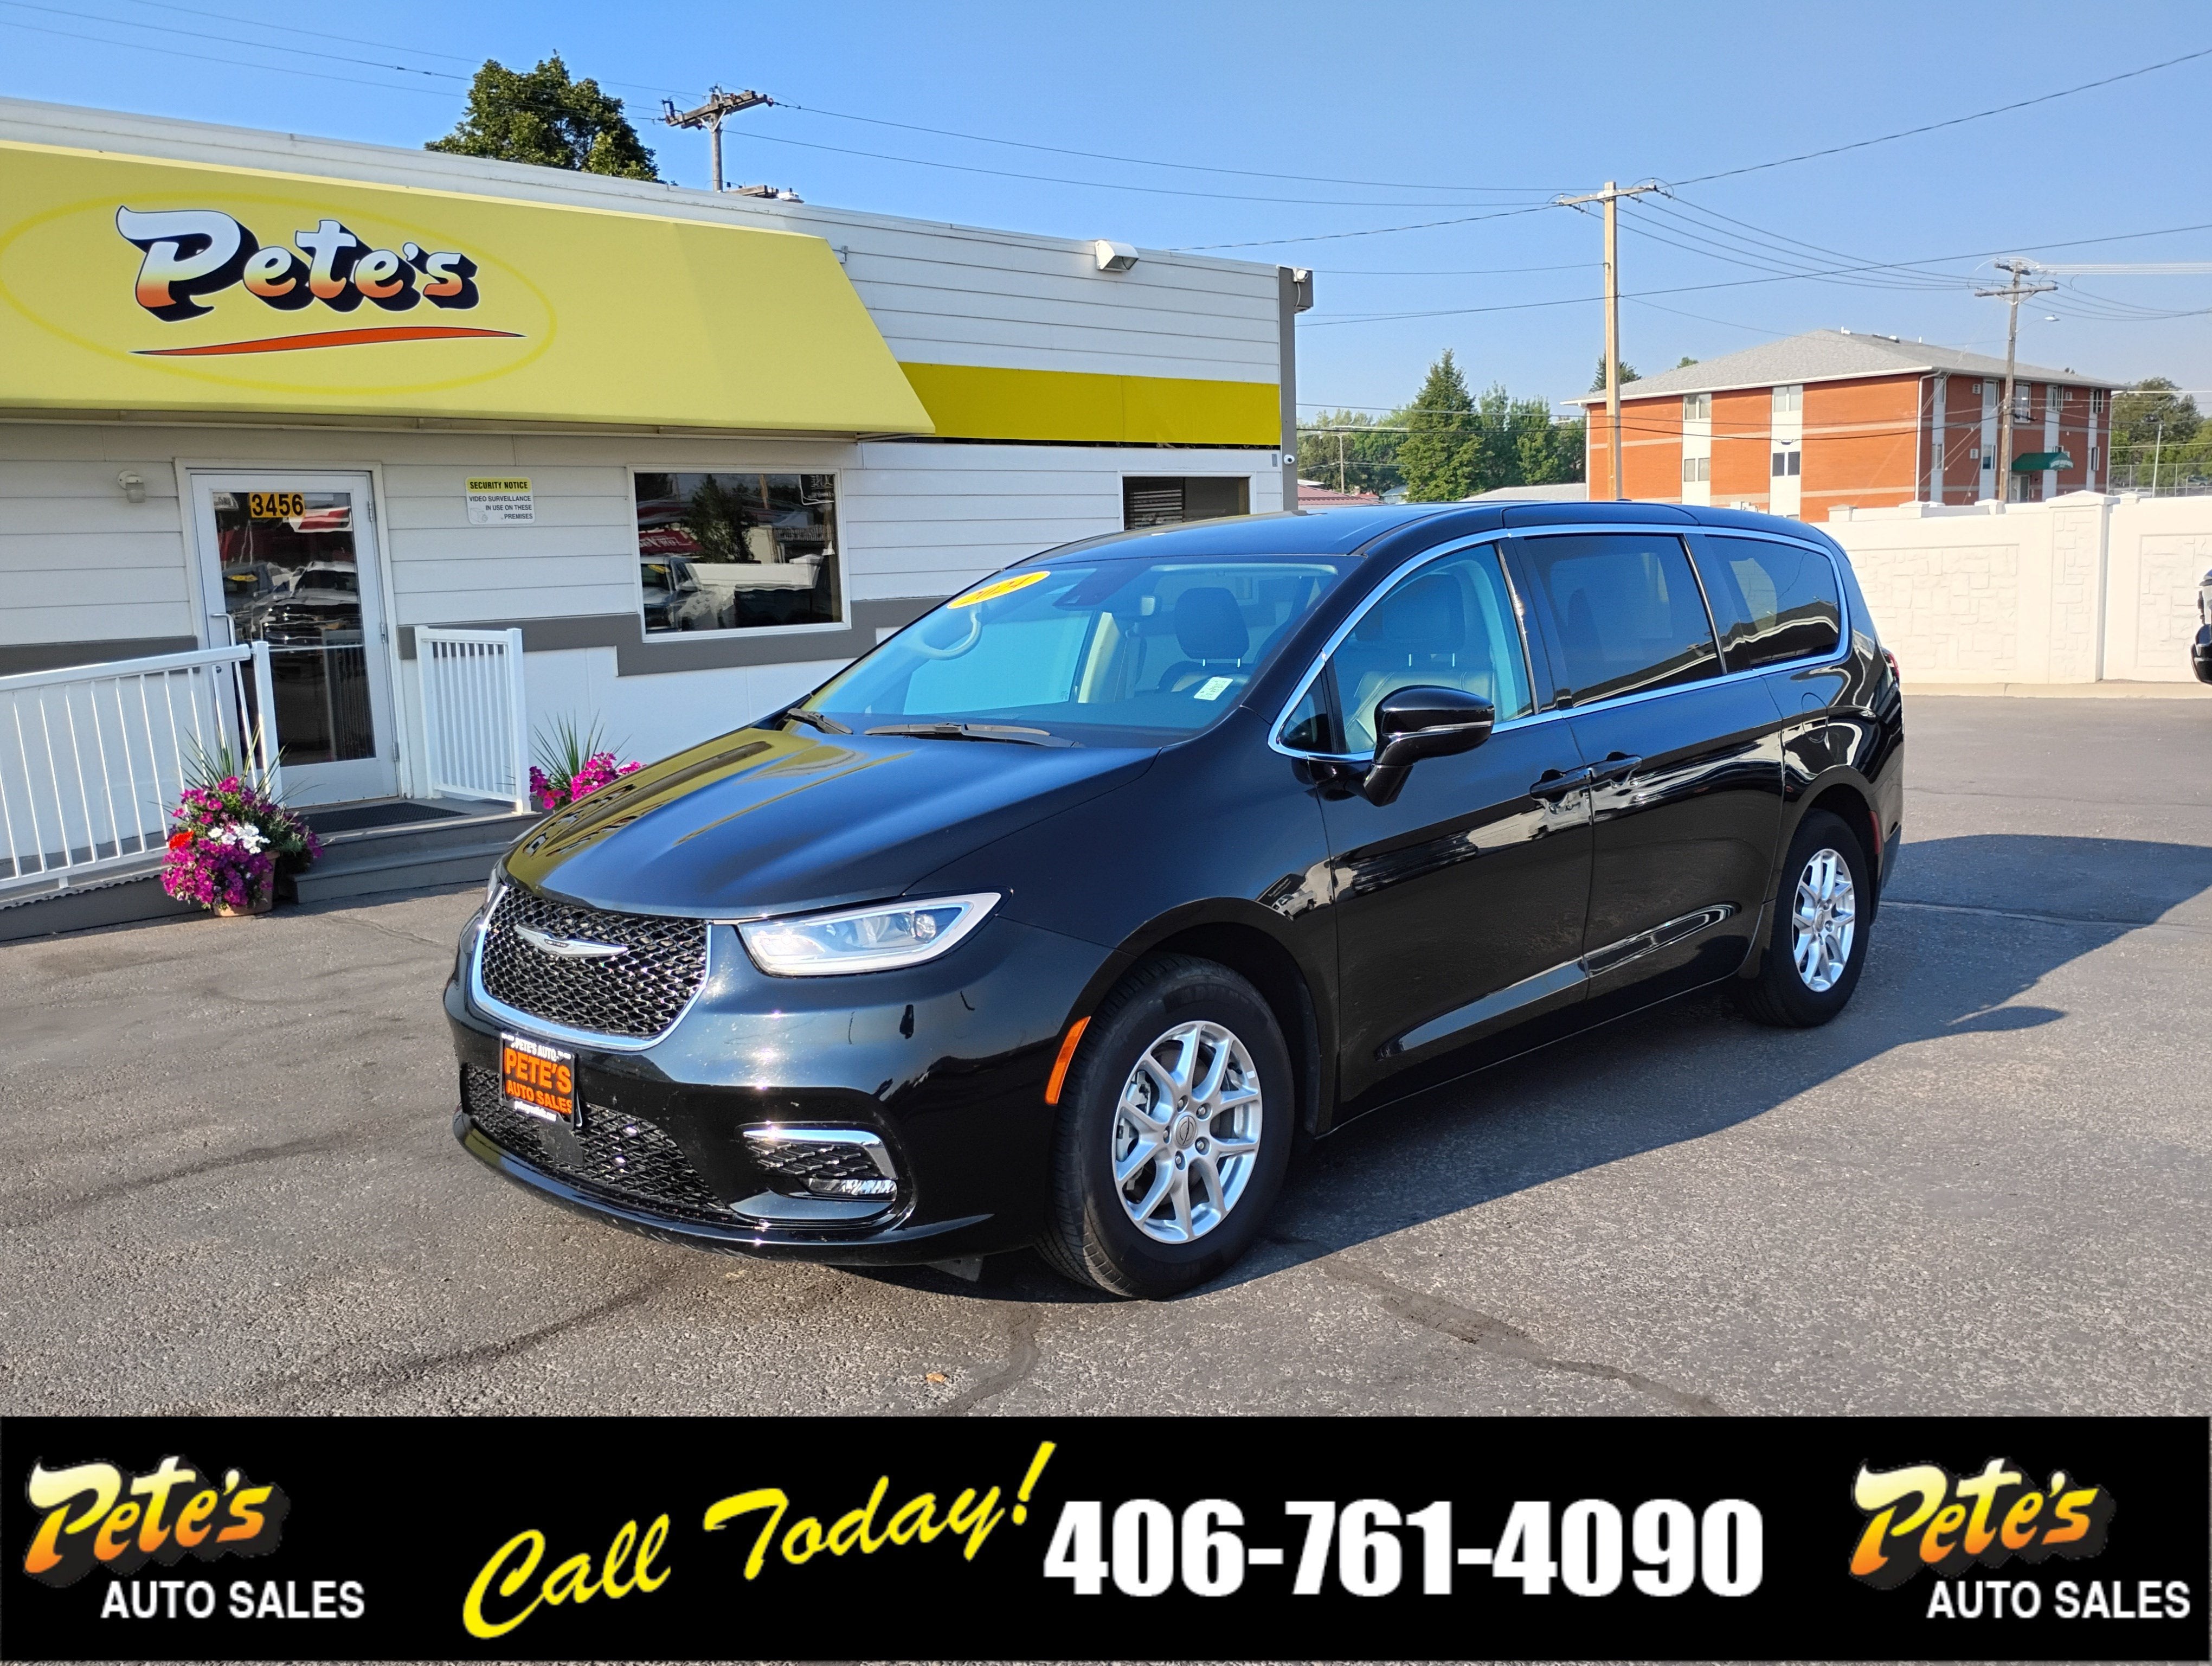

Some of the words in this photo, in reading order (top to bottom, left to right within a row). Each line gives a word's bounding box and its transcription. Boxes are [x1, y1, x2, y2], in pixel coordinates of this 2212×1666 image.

[115, 206, 479, 322] Pete's
[252, 494, 304, 516] 3456
[537, 1045, 557, 1062] AUTO
[504, 1048, 572, 1094] PETE'S
[506, 1080, 535, 1102] AUTO
[536, 1091, 573, 1114] SALES
